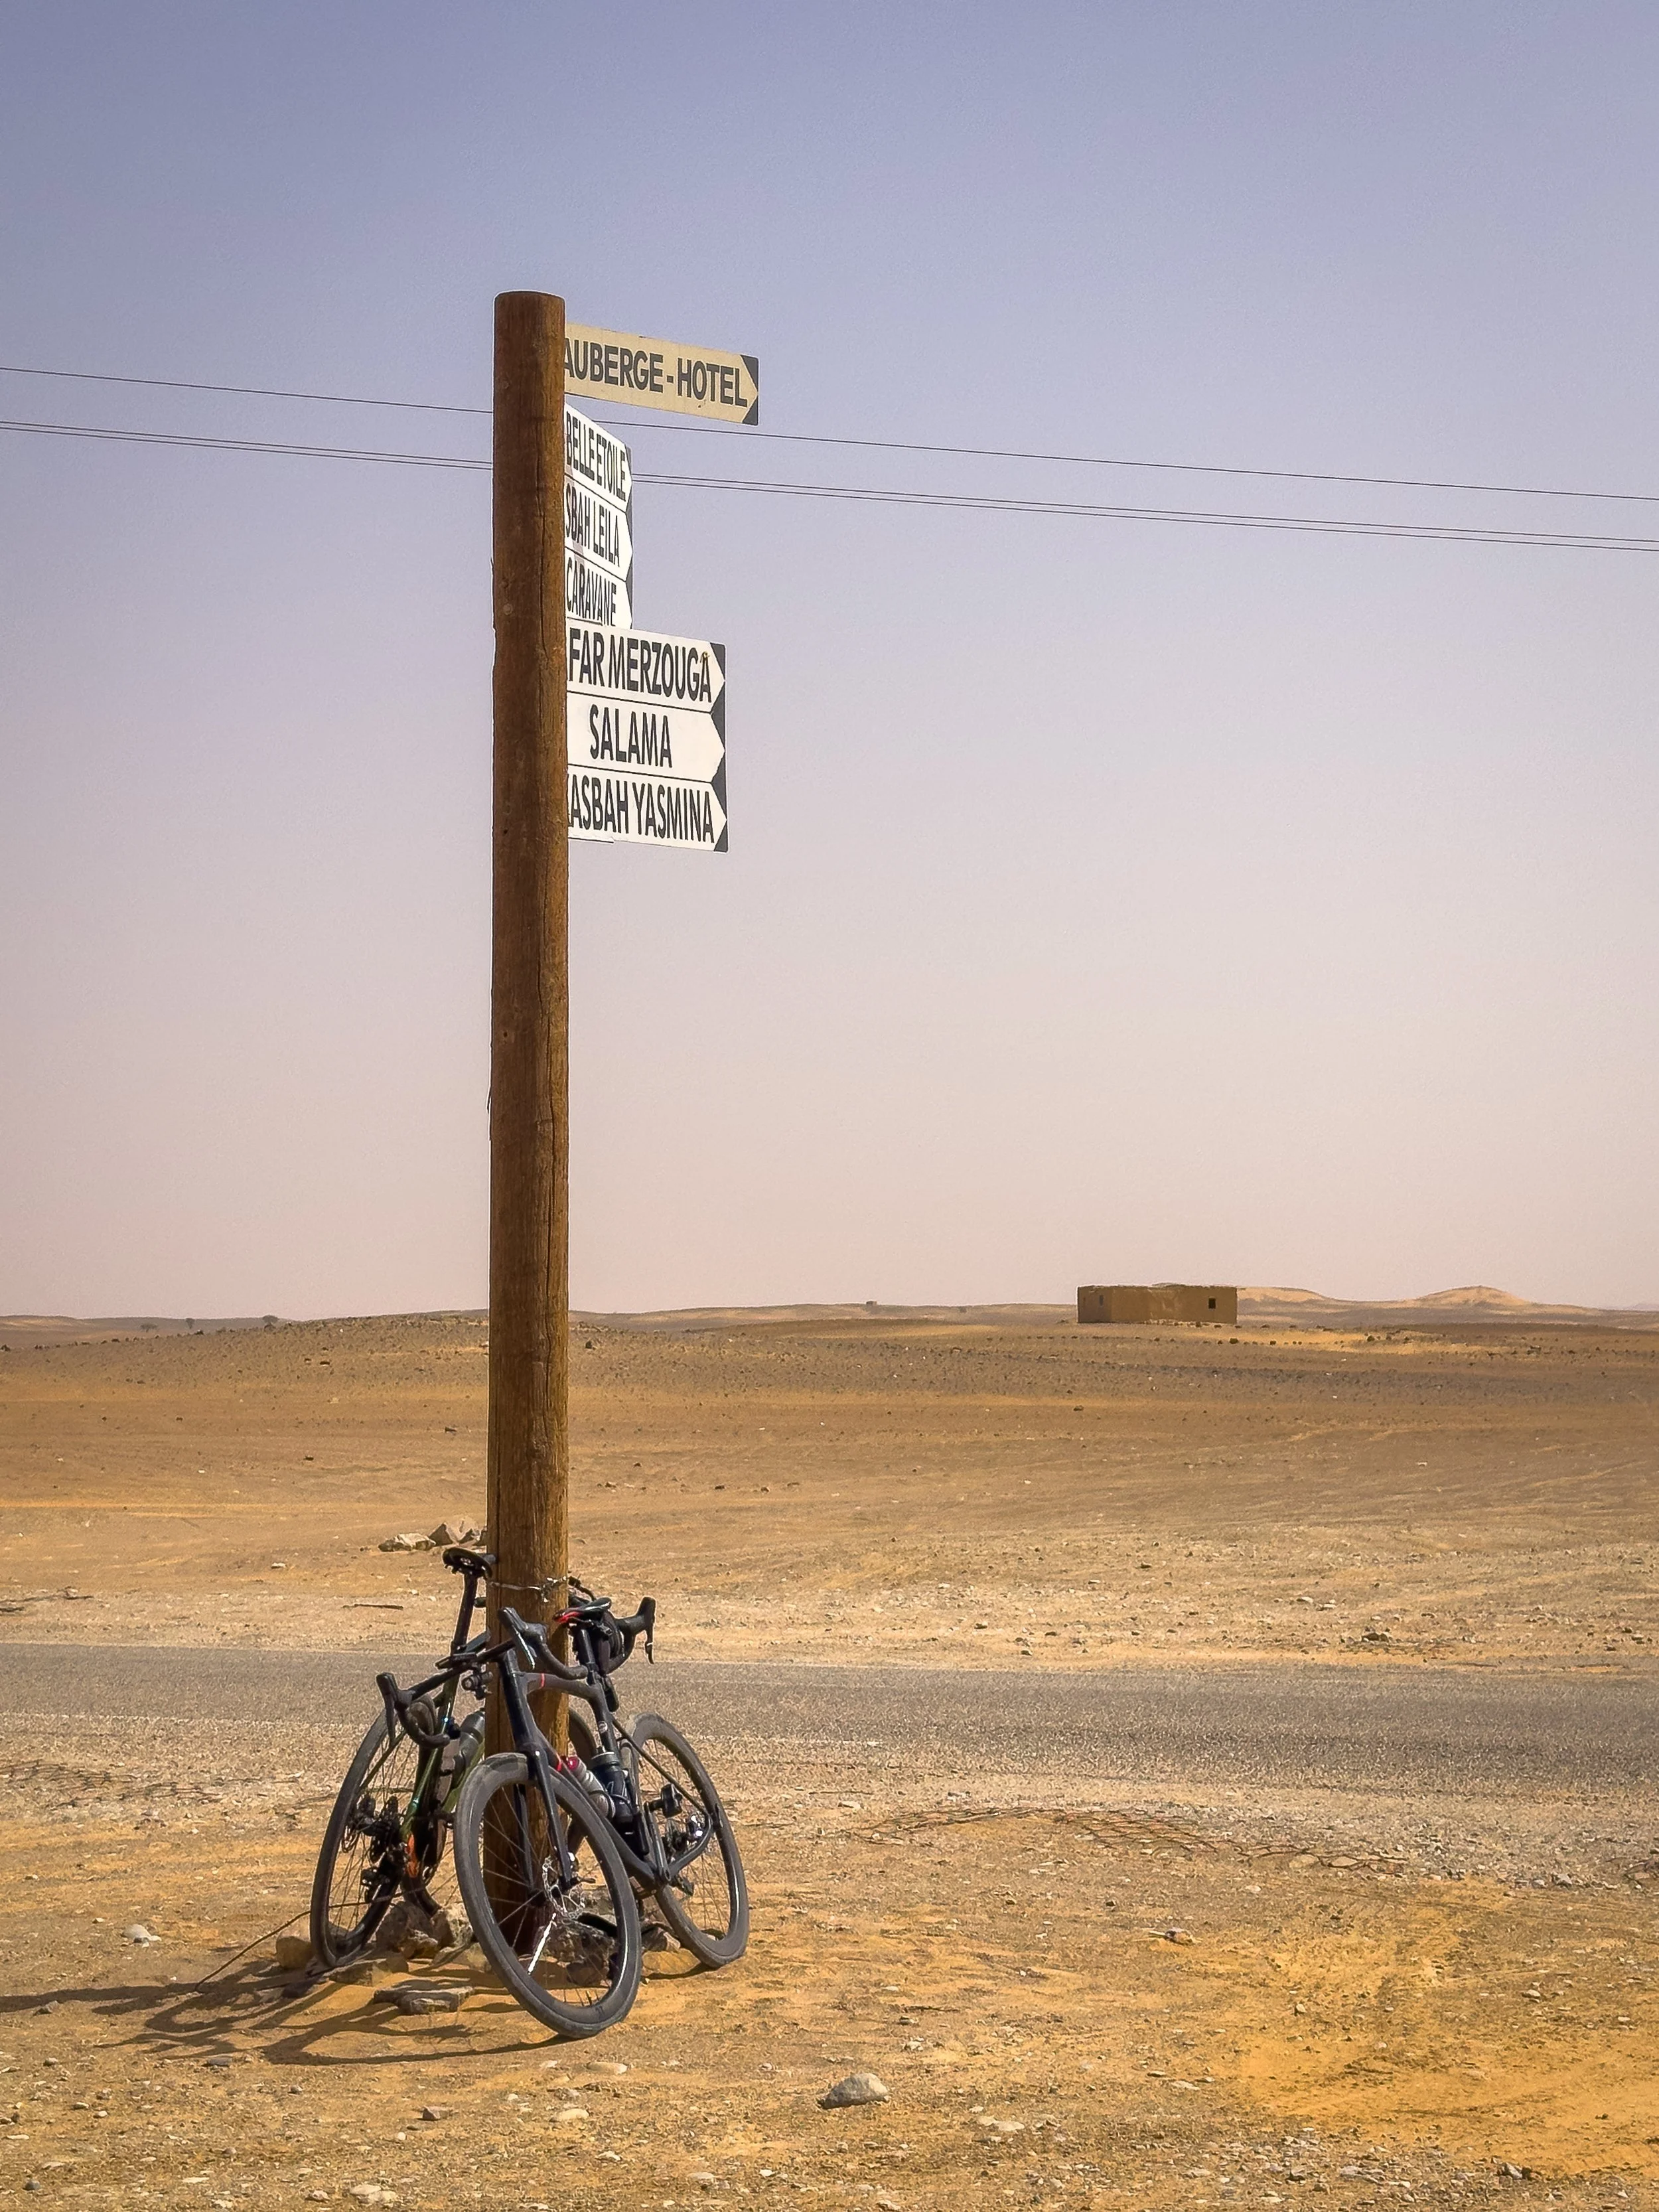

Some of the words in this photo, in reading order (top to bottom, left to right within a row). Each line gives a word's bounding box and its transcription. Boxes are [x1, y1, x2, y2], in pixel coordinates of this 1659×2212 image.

[566, 411, 595, 481] BELLE
[596, 433, 626, 502] ETOILE
[565, 482, 591, 550] SBAH
[593, 500, 620, 567] LEILA
[566, 557, 617, 627] CARAVANE
[569, 627, 605, 687] FAR
[608, 634, 712, 703] MERZOUGA
[589, 704, 673, 768] SALAMA
[567, 773, 629, 834] ASBAH
[632, 782, 715, 843] YASMINA
